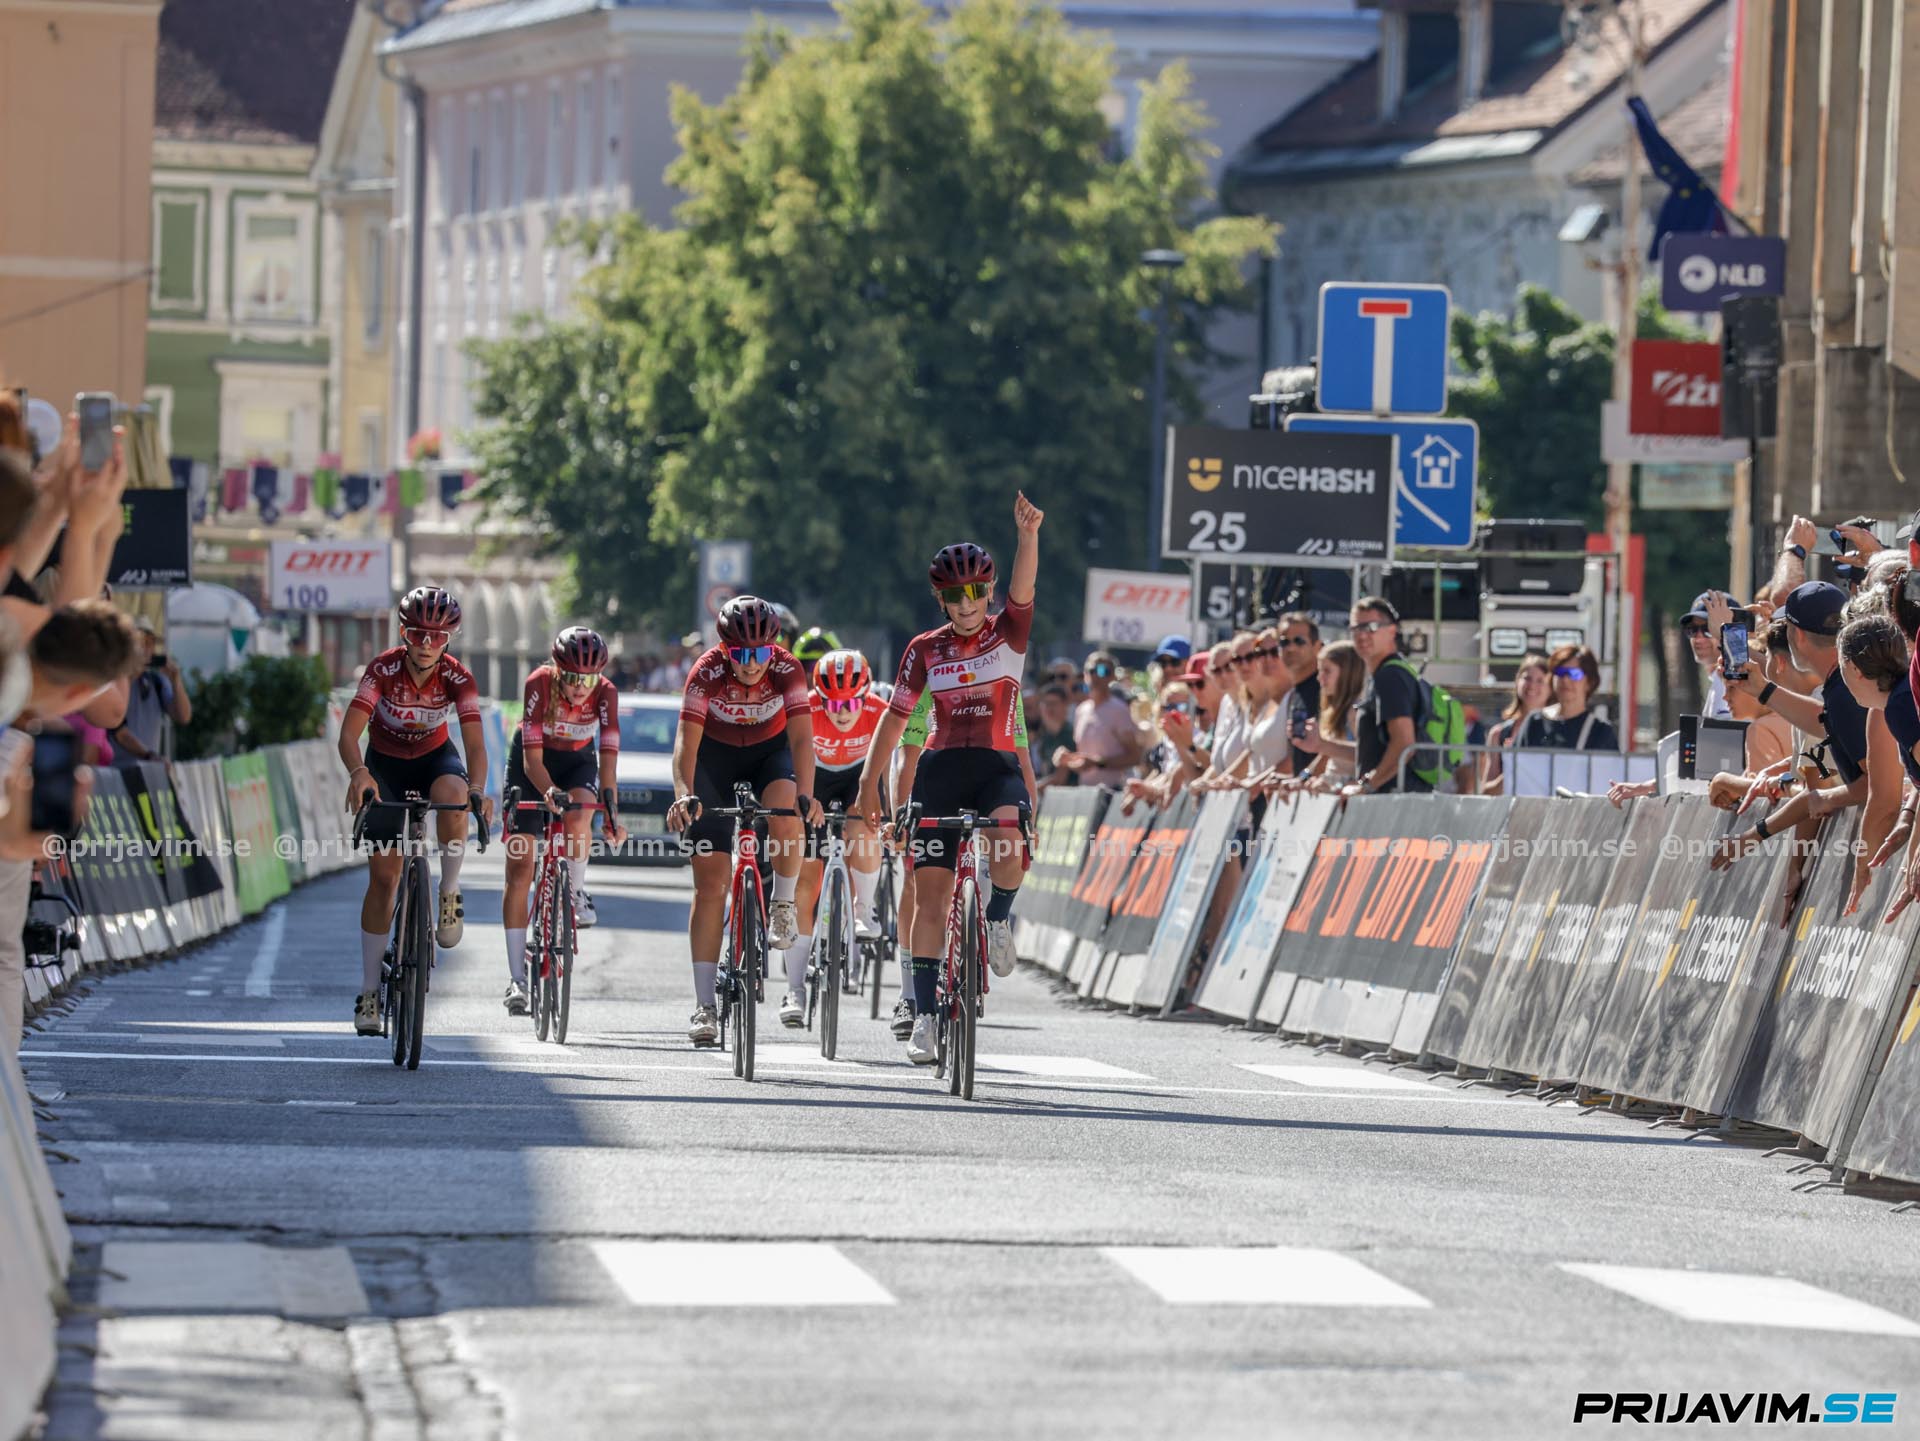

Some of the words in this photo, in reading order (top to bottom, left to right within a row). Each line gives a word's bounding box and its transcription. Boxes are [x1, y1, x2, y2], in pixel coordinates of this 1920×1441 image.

[1718, 264, 1767, 287] NLB
[1188, 510, 1247, 553] 25
[284, 550, 378, 573] DMT
[284, 585, 330, 609] 100
[1098, 615, 1145, 642] 100
[951, 704, 987, 717] FACTOR
